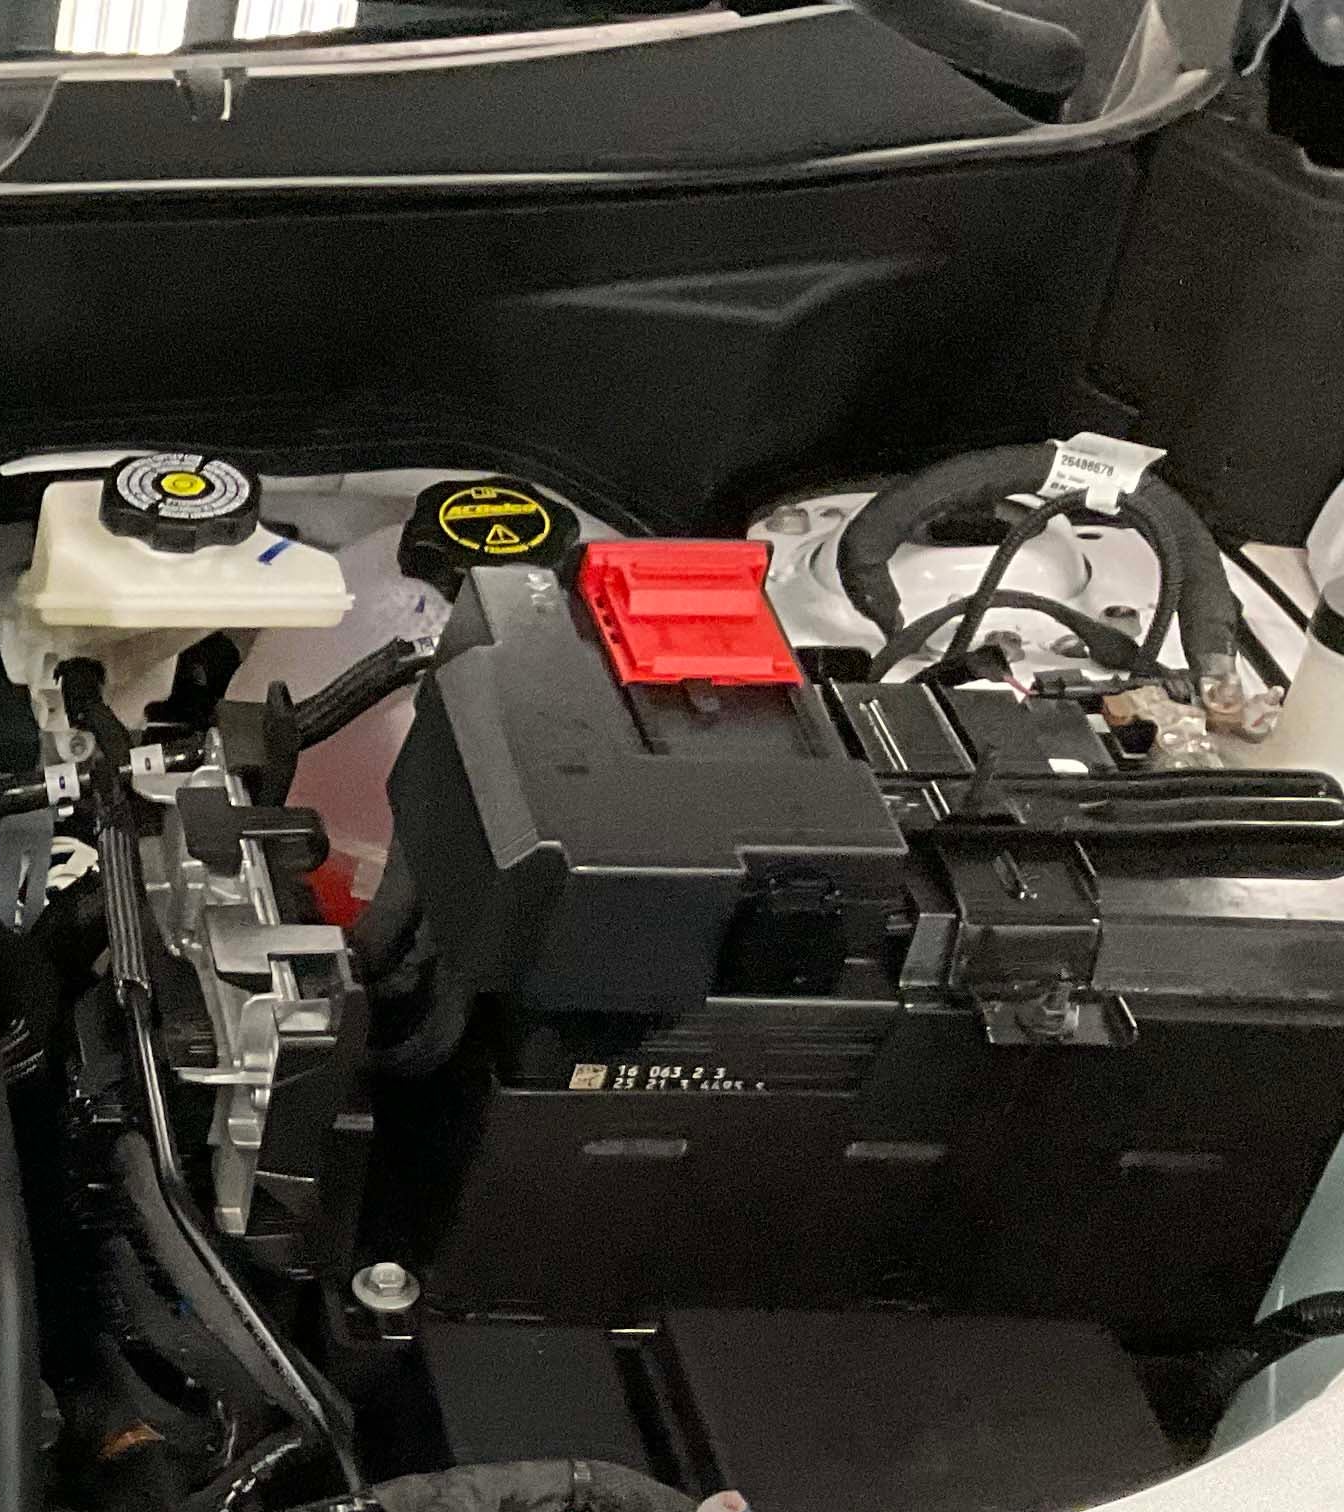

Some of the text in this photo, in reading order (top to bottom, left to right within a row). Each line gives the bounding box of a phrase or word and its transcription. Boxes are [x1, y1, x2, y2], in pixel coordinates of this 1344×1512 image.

[618, 1064, 727, 1079] 16 063 2 3
